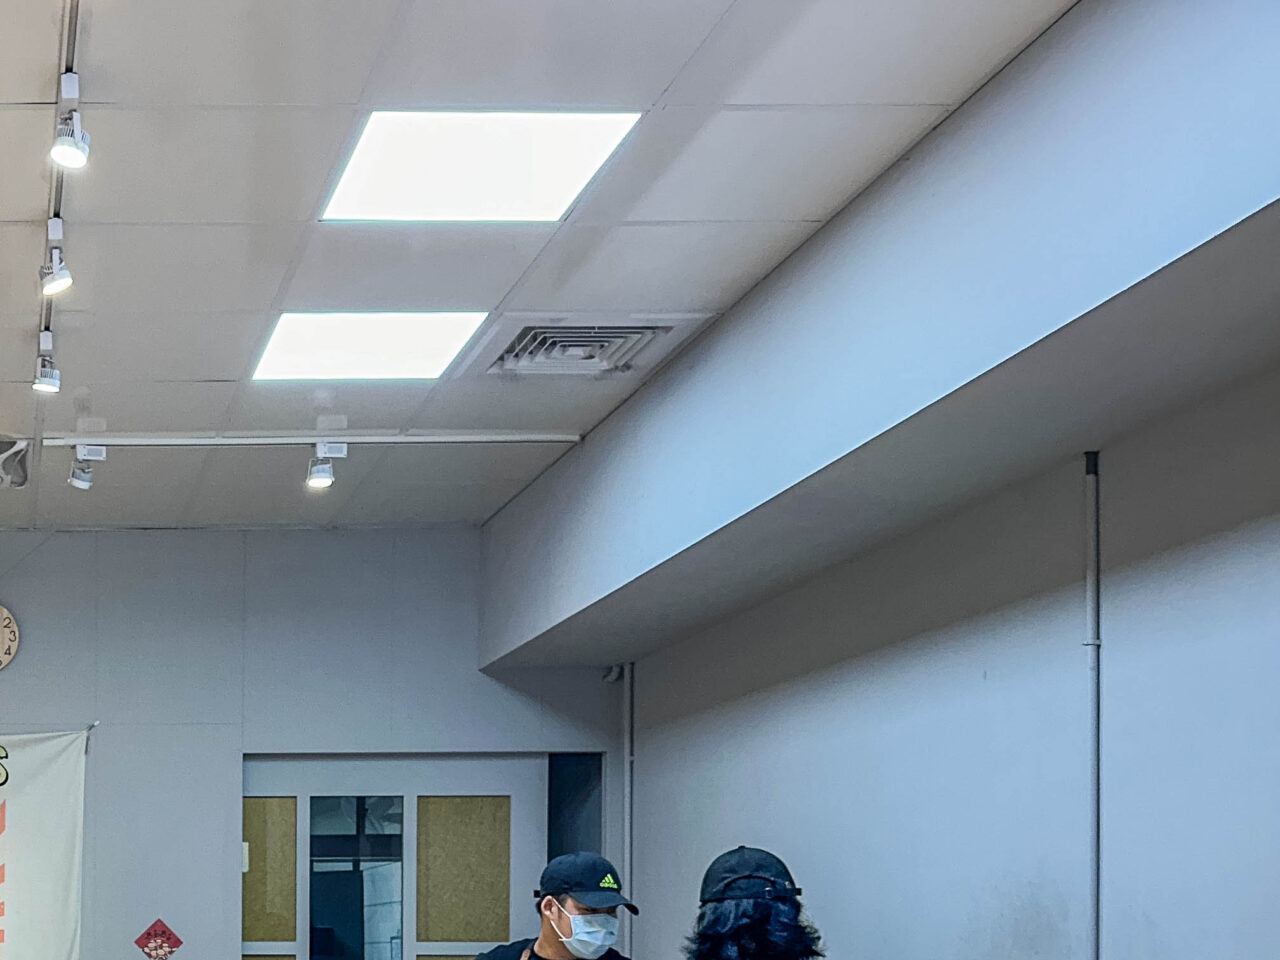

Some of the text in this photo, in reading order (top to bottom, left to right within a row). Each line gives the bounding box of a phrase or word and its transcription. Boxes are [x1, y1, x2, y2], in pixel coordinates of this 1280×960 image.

[3, 616, 12, 629] 2
[8, 630, 17, 642] 3
[4, 645, 12, 656] 4
